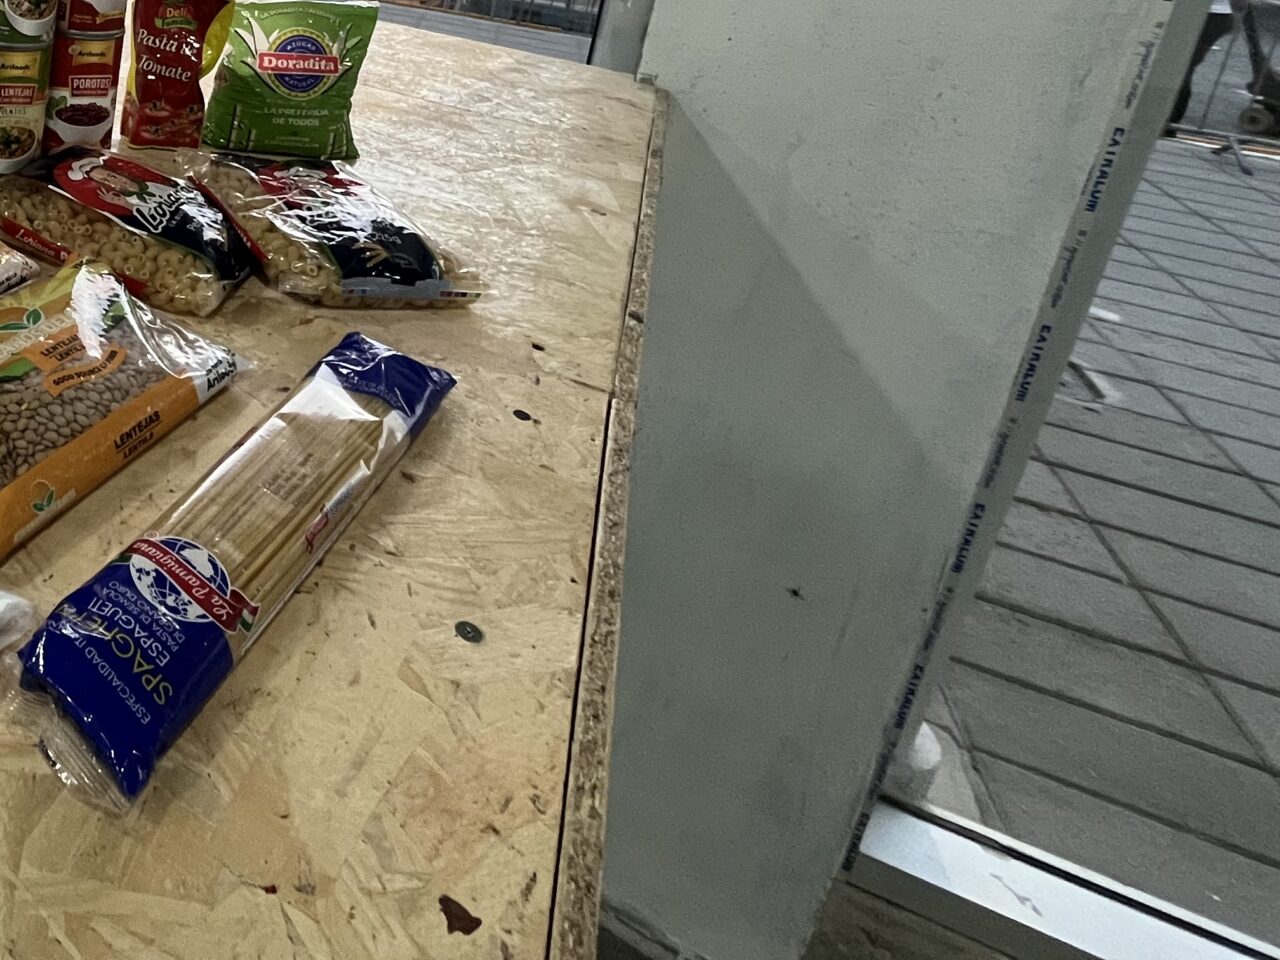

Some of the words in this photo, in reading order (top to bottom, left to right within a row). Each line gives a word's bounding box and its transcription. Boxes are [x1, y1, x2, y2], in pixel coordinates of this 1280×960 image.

[166, 7, 188, 17] Deli
[138, 29, 178, 53] Pasta
[139, 54, 192, 82] Tomate
[262, 55, 335, 72] Doradita
[1, 87, 33, 98] LENTEJAS
[73, 78, 110, 89] POROTOS
[288, 118, 320, 127] TODOS
[16, 229, 55, 257] Loriana
[52, 371, 75, 387] GOOD
[113, 409, 161, 450] LENTEJAS
[132, 541, 210, 600] Parmigiana
[101, 587, 138, 615] SEMOLA
[109, 580, 141, 607] DURO
[139, 613, 150, 625] DI
[211, 594, 233, 621] La
[87, 597, 171, 667] ESPAGUETI
[155, 626, 179, 652] PASTA
[84, 645, 152, 725] ESPECIALIDAD
